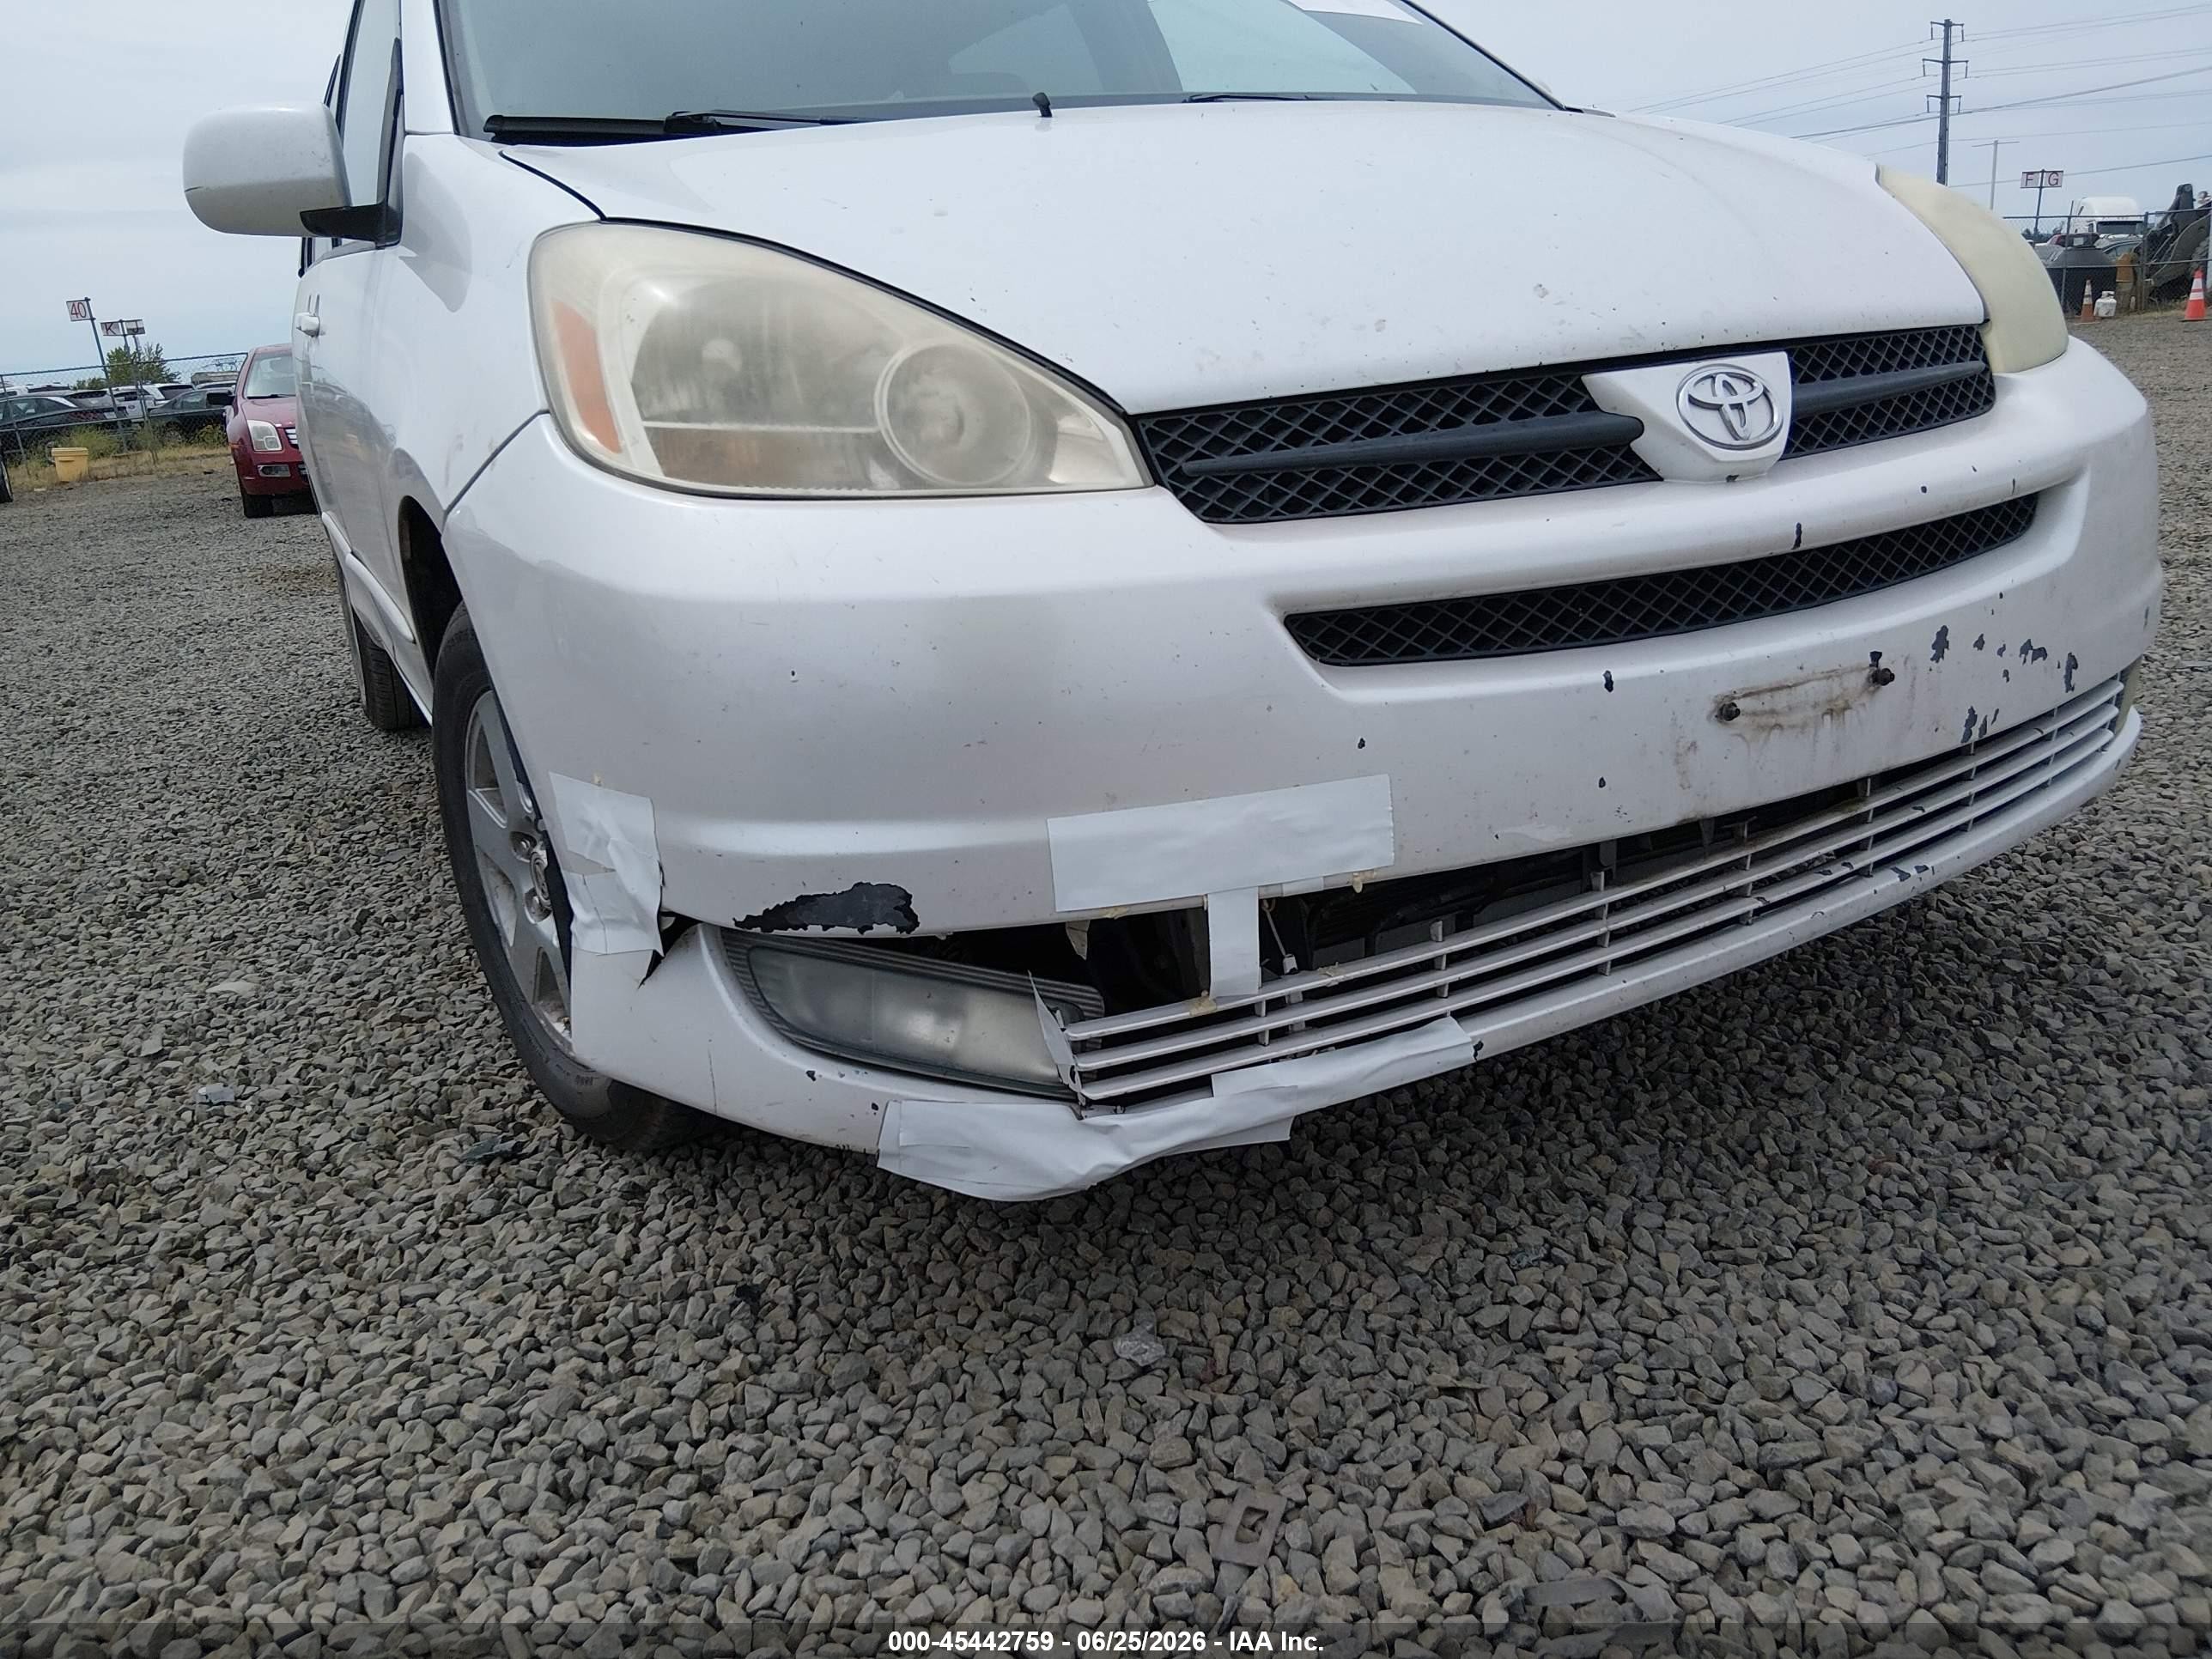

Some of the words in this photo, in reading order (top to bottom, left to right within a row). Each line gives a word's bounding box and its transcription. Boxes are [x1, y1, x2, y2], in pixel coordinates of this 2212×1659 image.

[2025, 173, 2034, 186] F
[2048, 172, 2059, 186] G
[70, 301, 87, 319] 40
[104, 322, 117, 335] K
